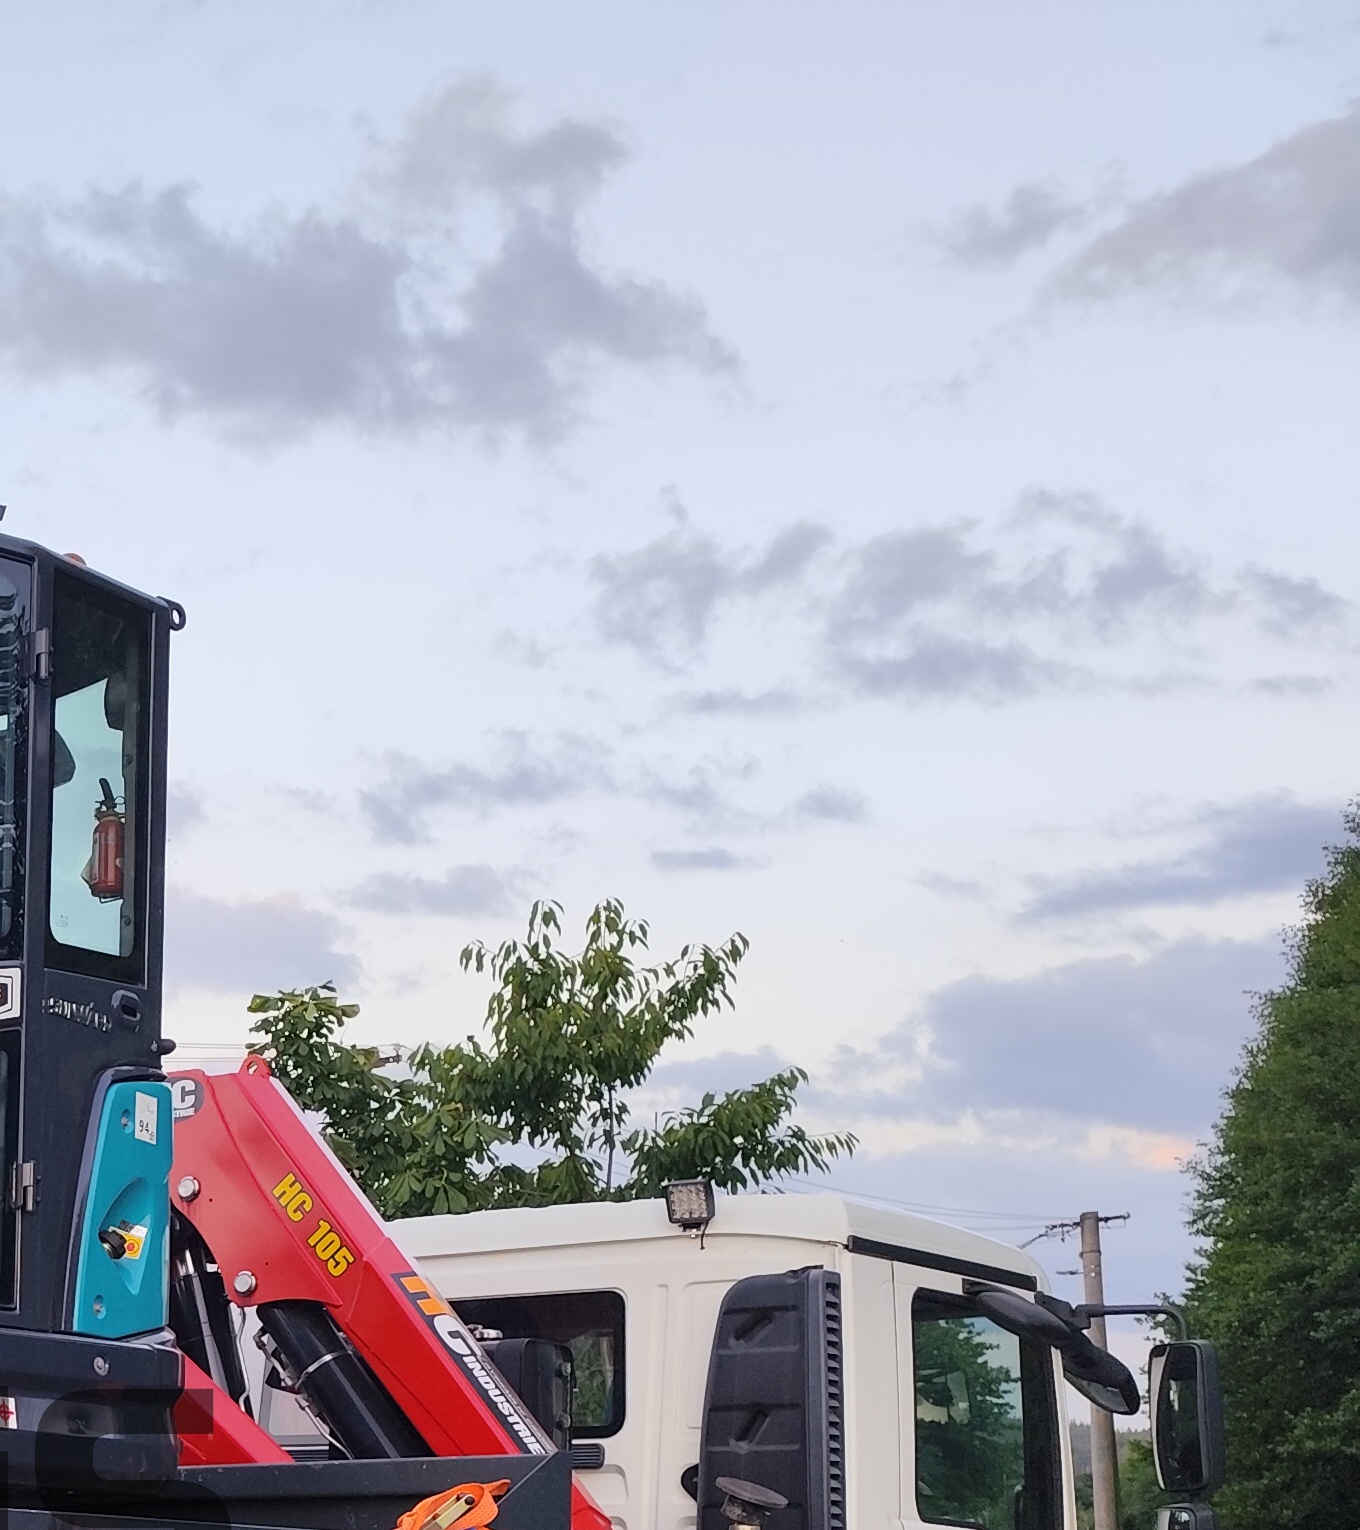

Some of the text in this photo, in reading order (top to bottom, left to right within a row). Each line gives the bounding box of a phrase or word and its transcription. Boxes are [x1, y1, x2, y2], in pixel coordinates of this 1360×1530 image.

[271, 1172, 357, 1278] HC 105
[462, 1354, 547, 1456] INDUSTRIE
